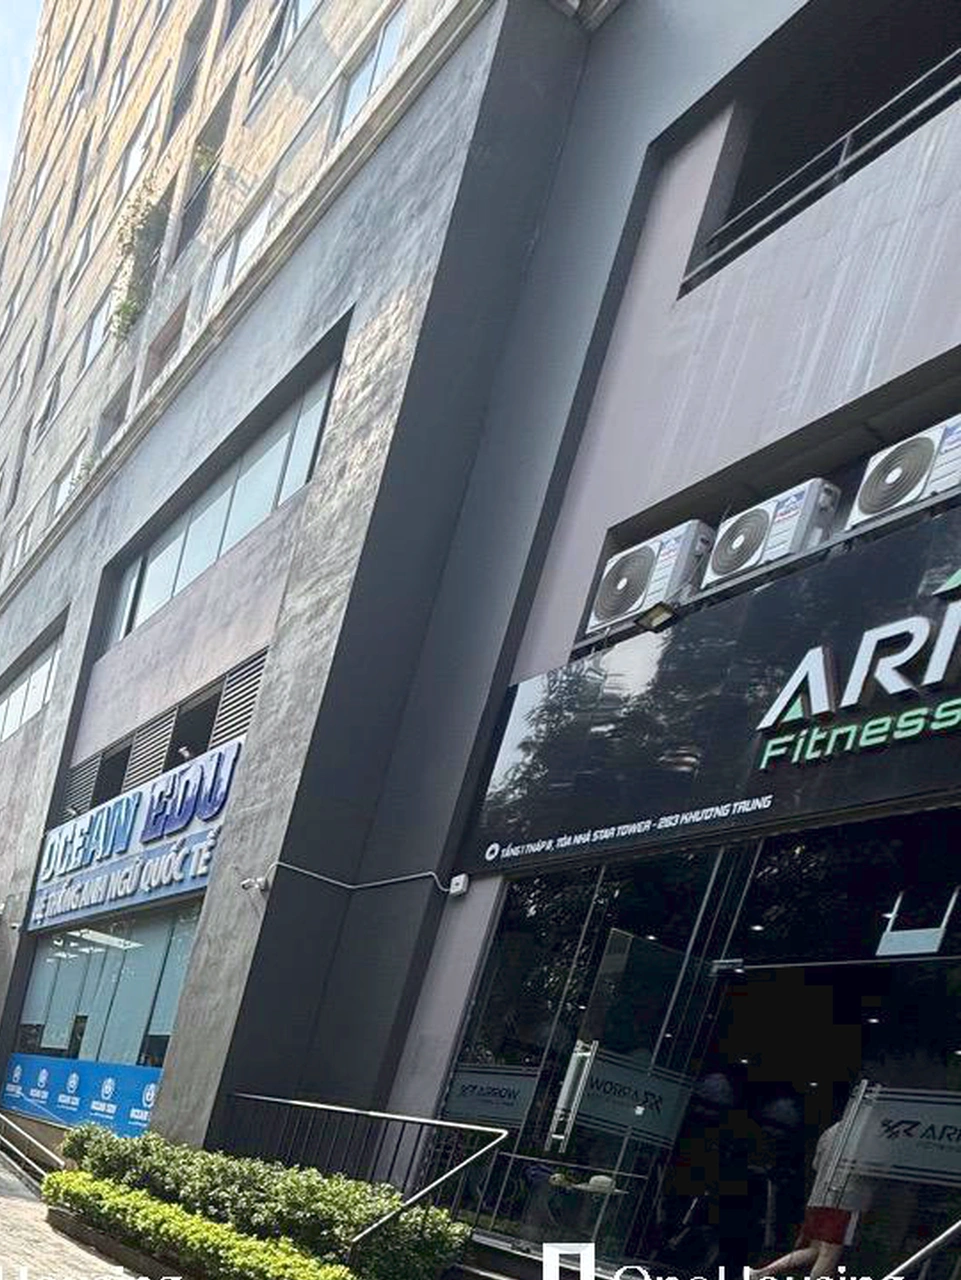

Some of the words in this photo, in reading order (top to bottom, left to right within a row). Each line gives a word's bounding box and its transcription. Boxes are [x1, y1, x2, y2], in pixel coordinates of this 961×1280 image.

[759, 698, 961, 770] Fitness
[41, 791, 143, 883] OCEAN
[141, 742, 242, 845] EDU
[592, 826, 615, 842] STAR
[616, 819, 652, 836] TOWER
[680, 803, 731, 825] KHƯƠNG
[732, 794, 773, 815] TRUNG
[46, 874, 81, 918] THỐNG
[80, 871, 109, 910] ANH
[107, 857, 142, 900] NGỮ
[142, 838, 189, 892] QUỐC
[190, 825, 221, 876] TẾ
